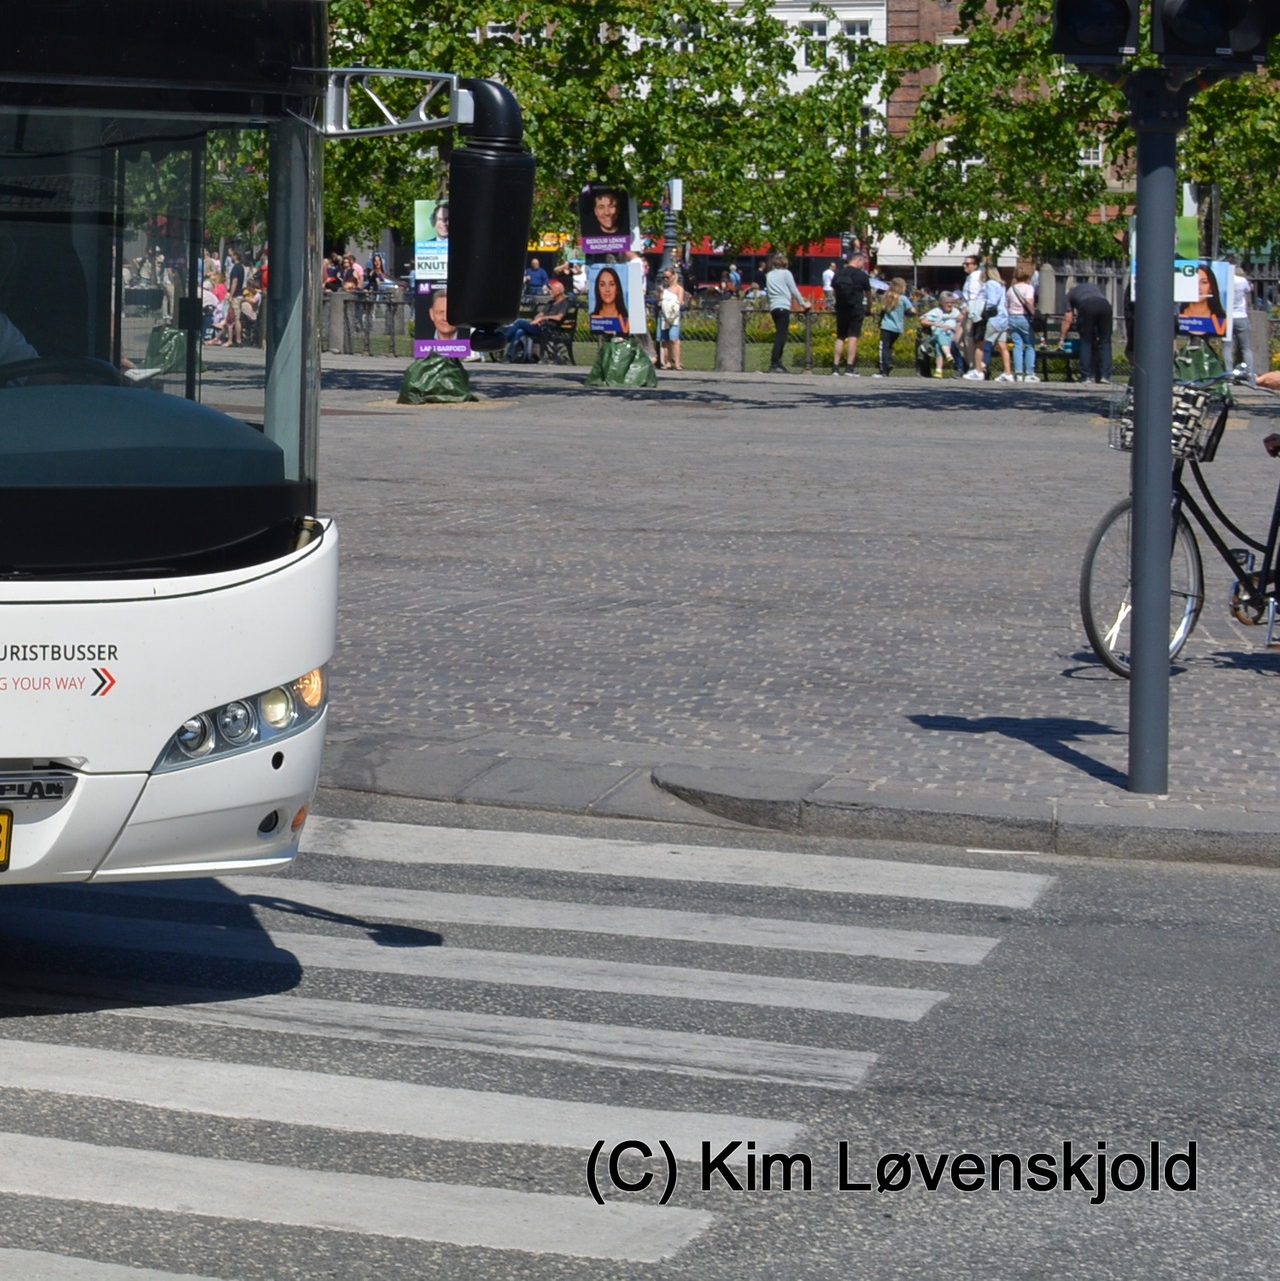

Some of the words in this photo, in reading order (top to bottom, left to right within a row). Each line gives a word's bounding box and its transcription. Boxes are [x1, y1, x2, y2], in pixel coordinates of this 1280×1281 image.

[1184, 266, 1194, 275] C
[420, 283, 429, 292] M
[12, 676, 52, 691] YOUR
[55, 676, 86, 690] WAY
